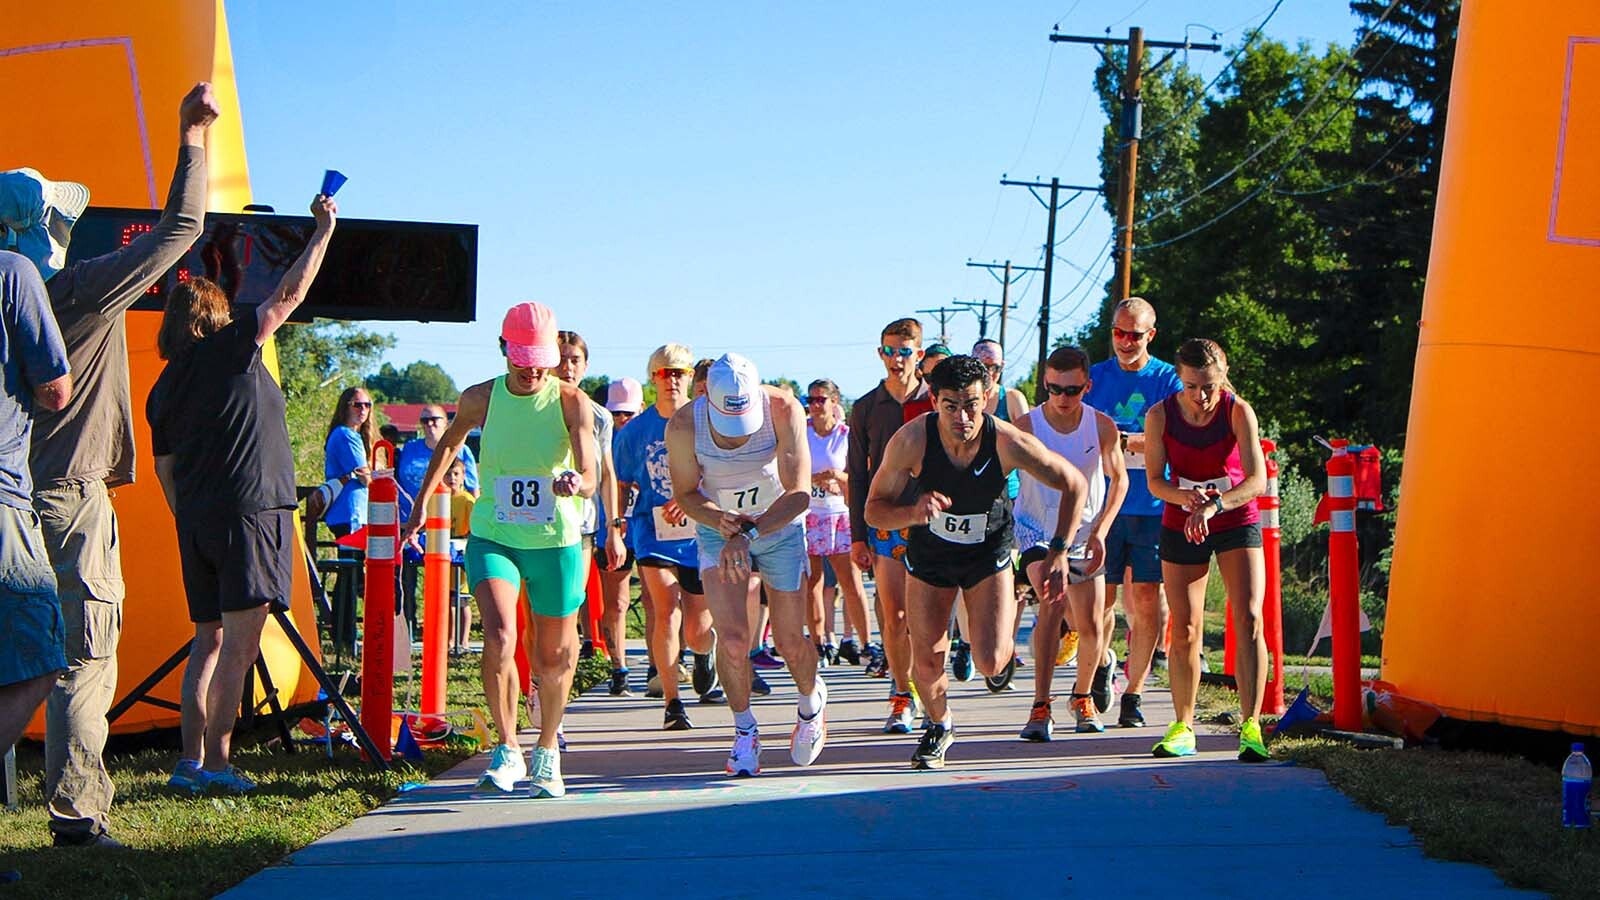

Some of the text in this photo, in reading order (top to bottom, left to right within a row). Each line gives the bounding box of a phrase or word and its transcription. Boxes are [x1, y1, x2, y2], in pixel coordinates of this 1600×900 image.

[511, 480, 540, 507] 83
[733, 486, 759, 509] 77
[945, 516, 971, 535] 64
